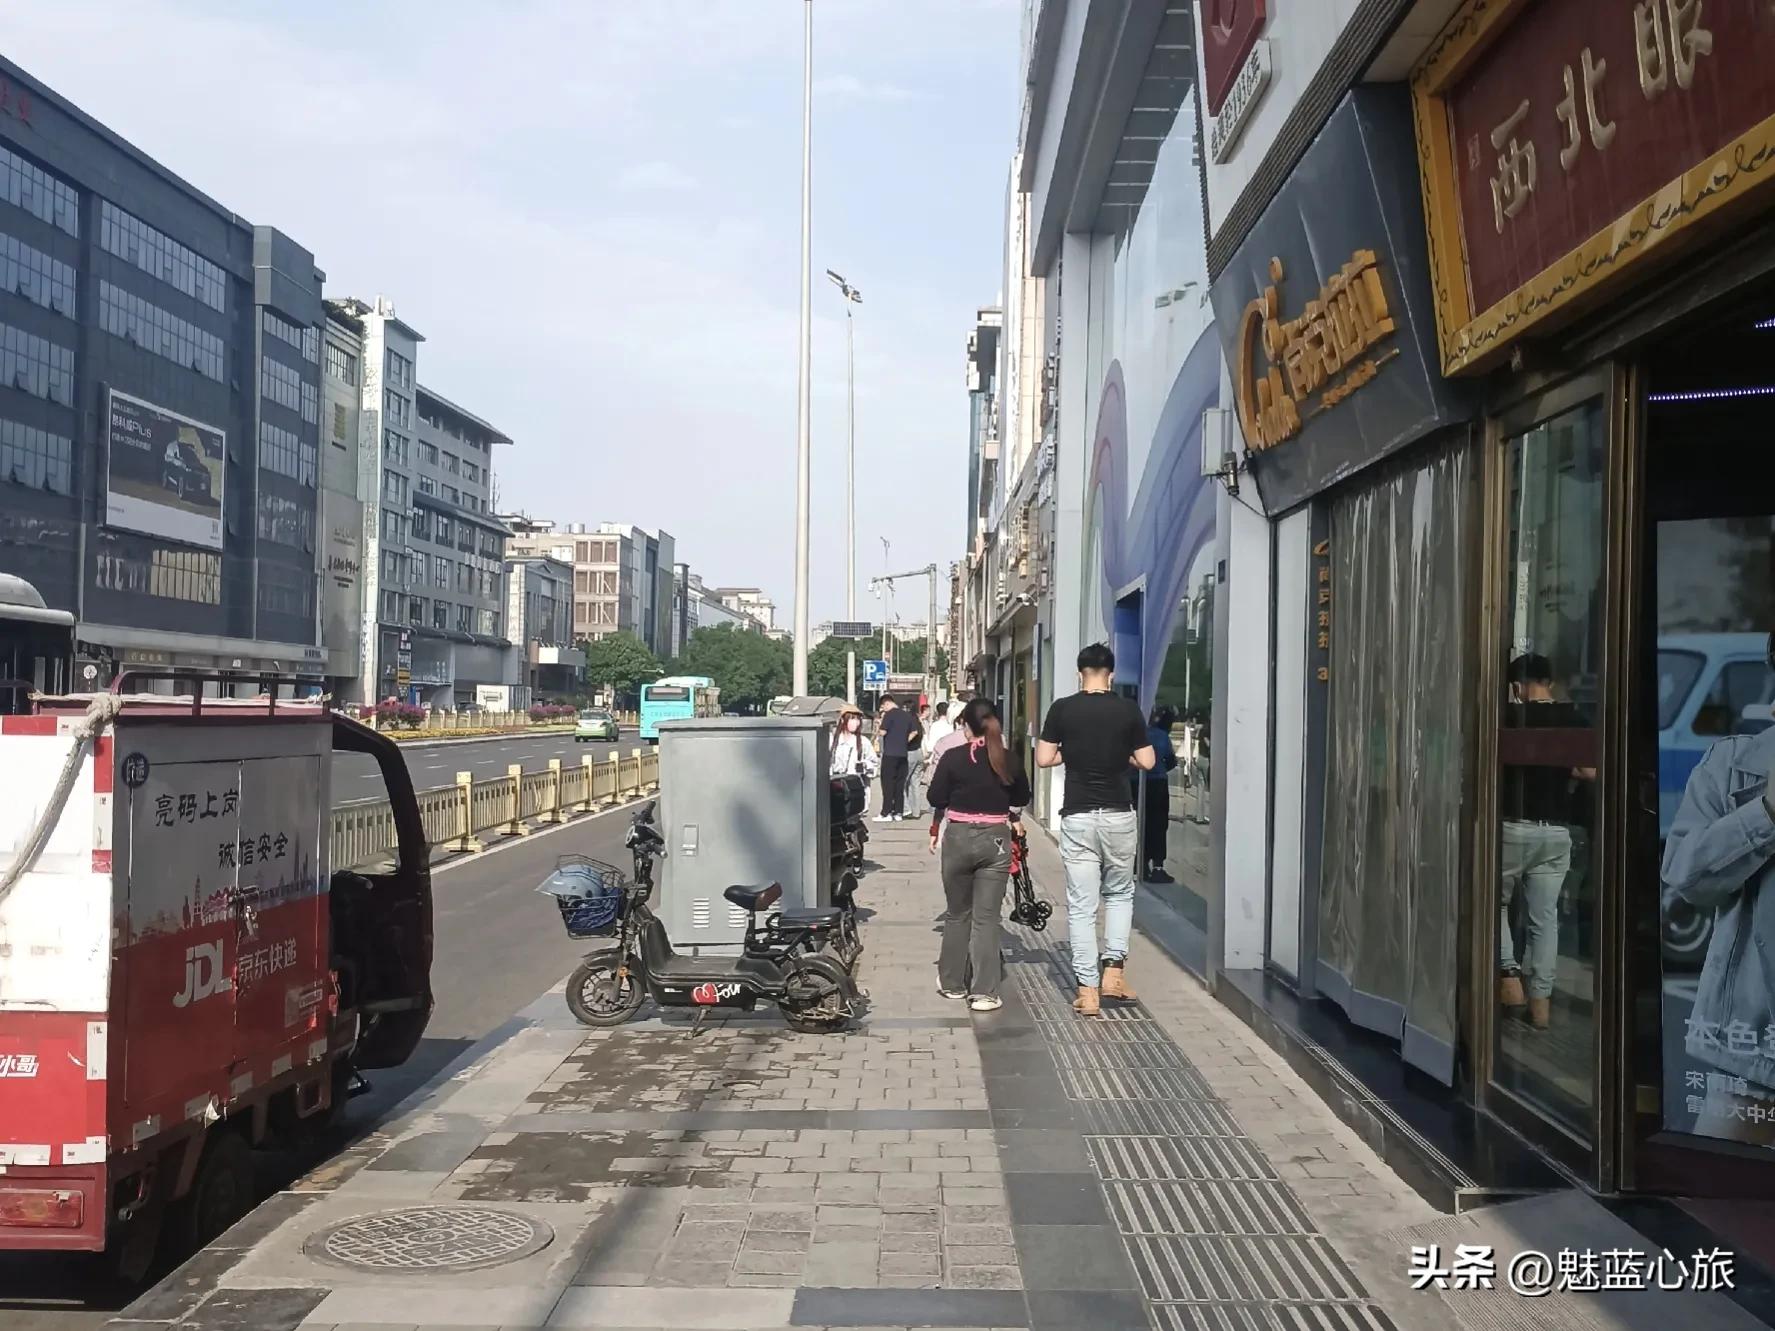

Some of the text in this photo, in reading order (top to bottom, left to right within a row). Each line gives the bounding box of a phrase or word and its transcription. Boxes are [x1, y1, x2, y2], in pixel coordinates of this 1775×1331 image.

[865, 663, 877, 680] P
[154, 788, 240, 827] 亮码上岗
[217, 831, 289, 869] 诚信安全
[173, 938, 233, 1008] JDL
[238, 937, 297, 984] 京东快递
[1685, 1094, 1775, 1124] 雷大中
